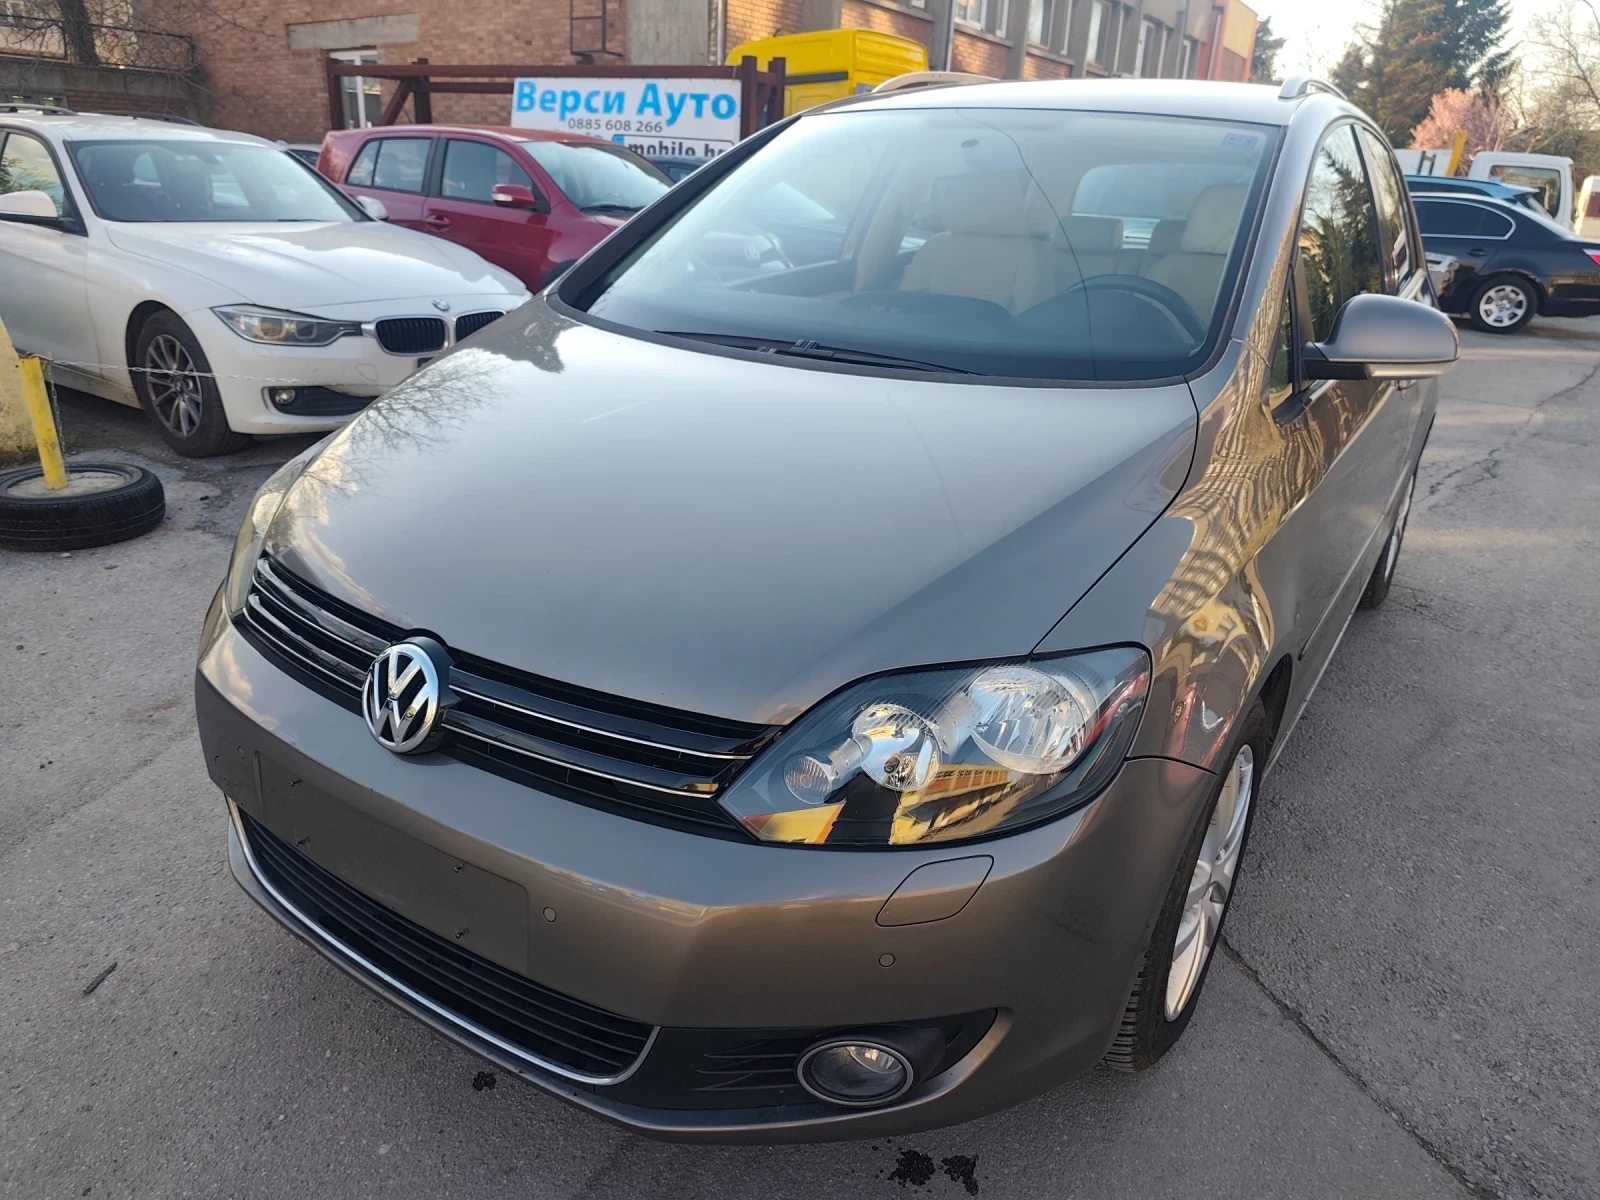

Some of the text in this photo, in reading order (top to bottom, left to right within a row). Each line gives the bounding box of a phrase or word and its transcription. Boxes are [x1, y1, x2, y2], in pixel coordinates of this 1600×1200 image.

[516, 81, 737, 127] Верси Ауто
[568, 118, 663, 133] 0885 608 266
